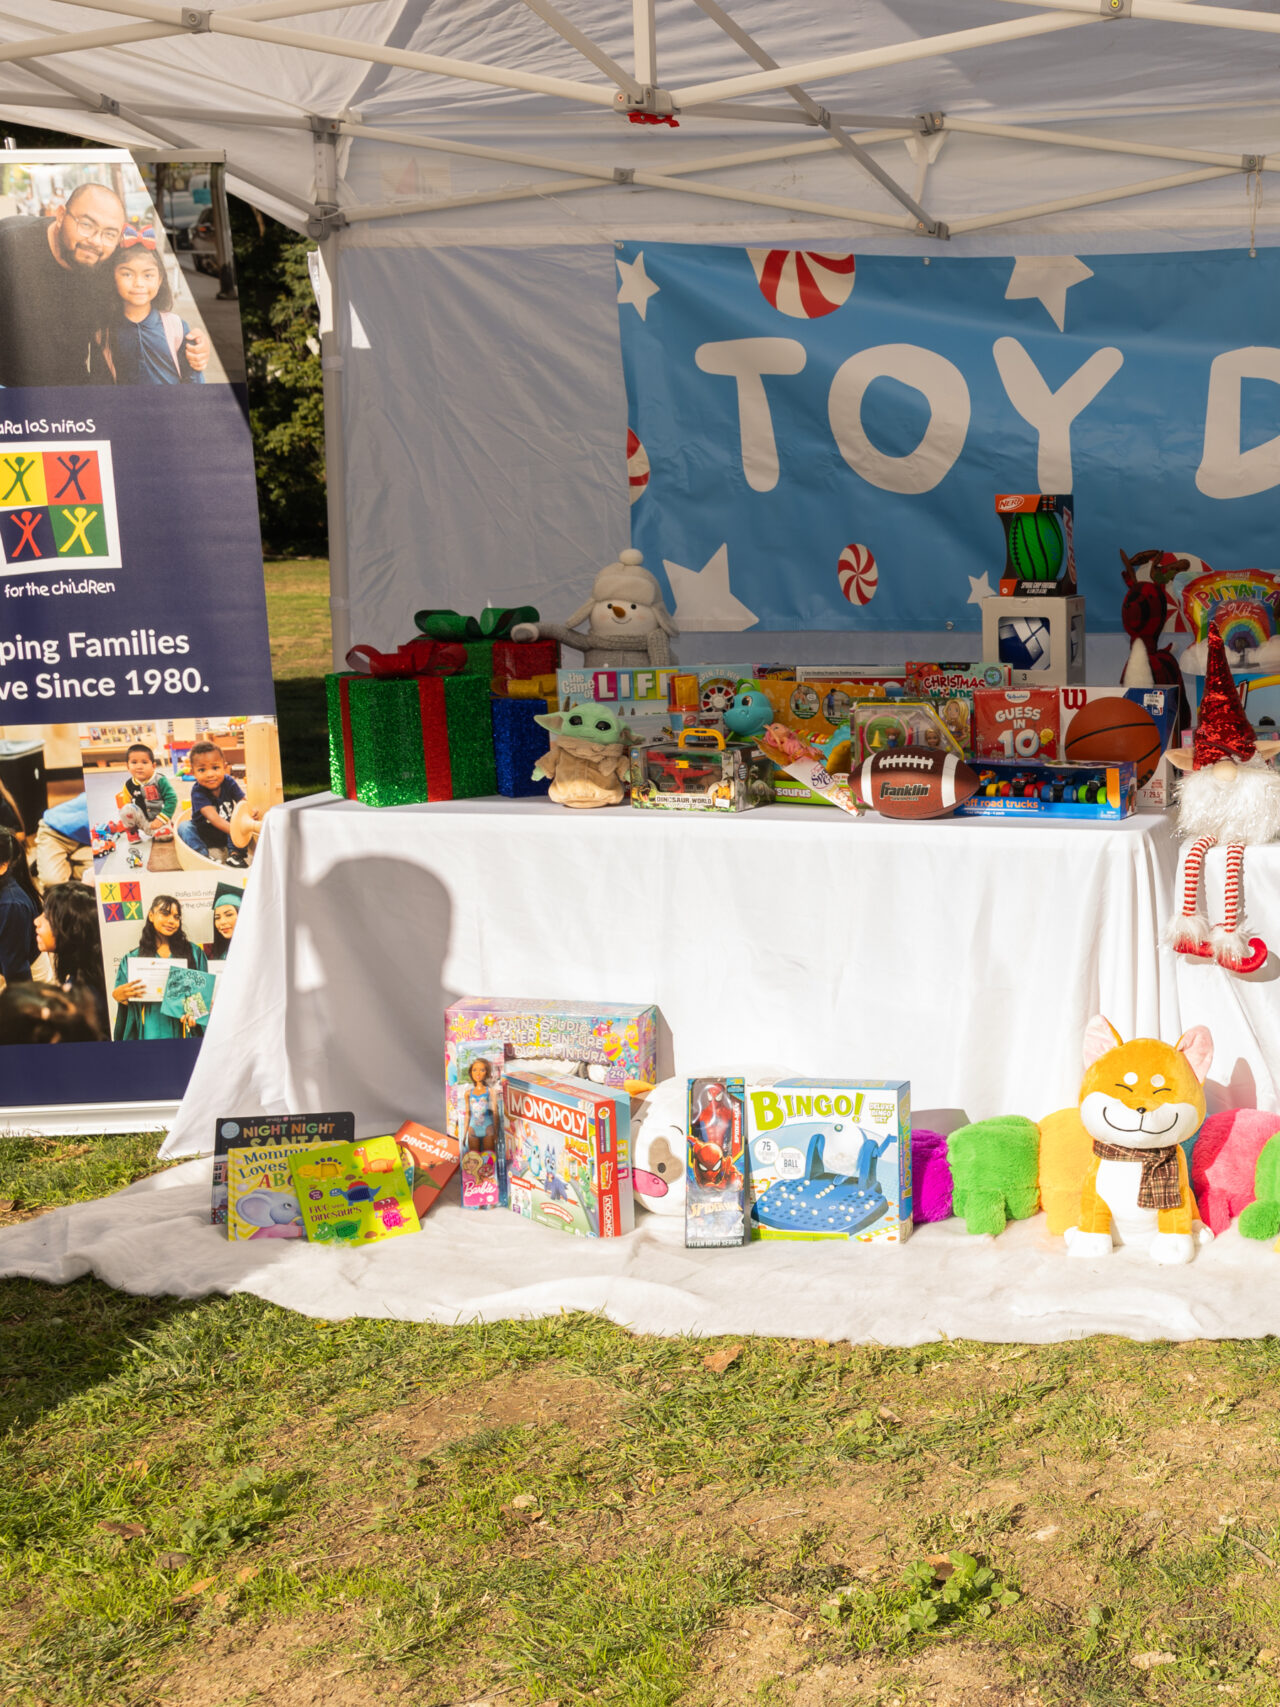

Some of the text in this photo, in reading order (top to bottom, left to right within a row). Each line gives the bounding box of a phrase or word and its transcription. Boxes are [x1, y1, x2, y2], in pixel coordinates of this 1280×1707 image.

[694, 336, 1124, 495] TOY
[1000, 497, 1023, 509] NERF
[4, 584, 24, 598] for
[25, 582, 50, 596] the
[1228, 602, 1251, 617] Kit
[68, 629, 190, 658] Families
[35, 672, 115, 699] Since
[125, 667, 210, 695] 1980.
[568, 672, 584, 683] the
[924, 675, 985, 689] CHRISTMAS
[1022, 673, 1027, 681] 3
[562, 680, 595, 694] Game
[584, 689, 595, 699] of
[995, 707, 1041, 722] GUESS
[1013, 720, 1026, 729] IN
[998, 729, 1040, 758] 10
[656, 796, 690, 804] DINOSAUR
[964, 798, 1039, 809] off road trucks
[499, 1017, 537, 1033] PAINT
[540, 1017, 590, 1034] STUDIO
[540, 1031, 604, 1049] PEINTURE
[552, 1046, 608, 1063] PINTURA
[610, 1070, 624, 1080] 24
[511, 1092, 586, 1137] MONOPOLY
[750, 1091, 865, 1131] BINGO!
[243, 1123, 335, 1138] NIGHT NIGHT
[400, 1134, 458, 1164] DINOSAURS
[762, 1141, 771, 1151] 75
[243, 1148, 309, 1165] Momm
[783, 1158, 798, 1168] BALL
[238, 1161, 287, 1179] Loves
[464, 1181, 497, 1197] Barbie
